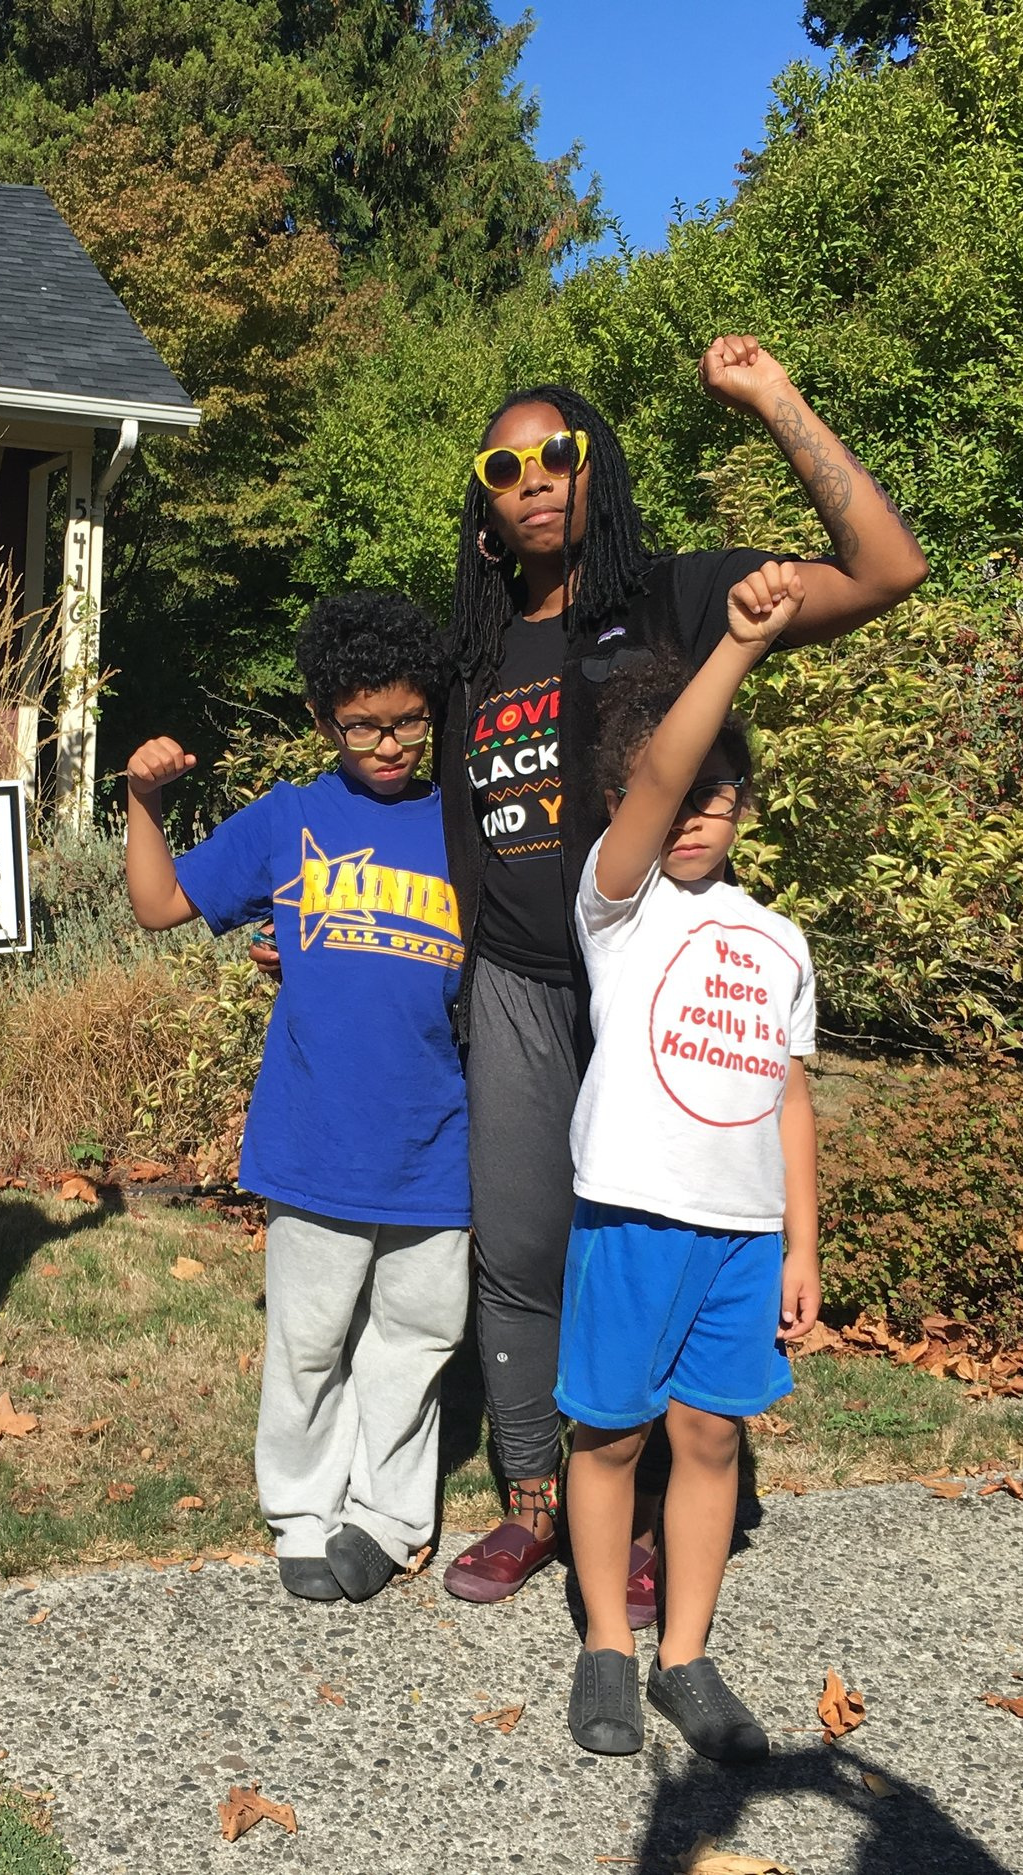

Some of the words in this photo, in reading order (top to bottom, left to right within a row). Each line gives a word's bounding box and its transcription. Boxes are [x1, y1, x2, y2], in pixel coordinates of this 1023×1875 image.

[327, 929, 379, 944] ALL
[390, 935, 464, 963] STARS
[715, 939, 761, 974] Yes,
[705, 974, 768, 1005] there
[679, 1005, 746, 1043] really
[755, 1015, 769, 1041] is
[775, 1028, 786, 1047] a
[660, 1030, 786, 1081] Kalamazoo
